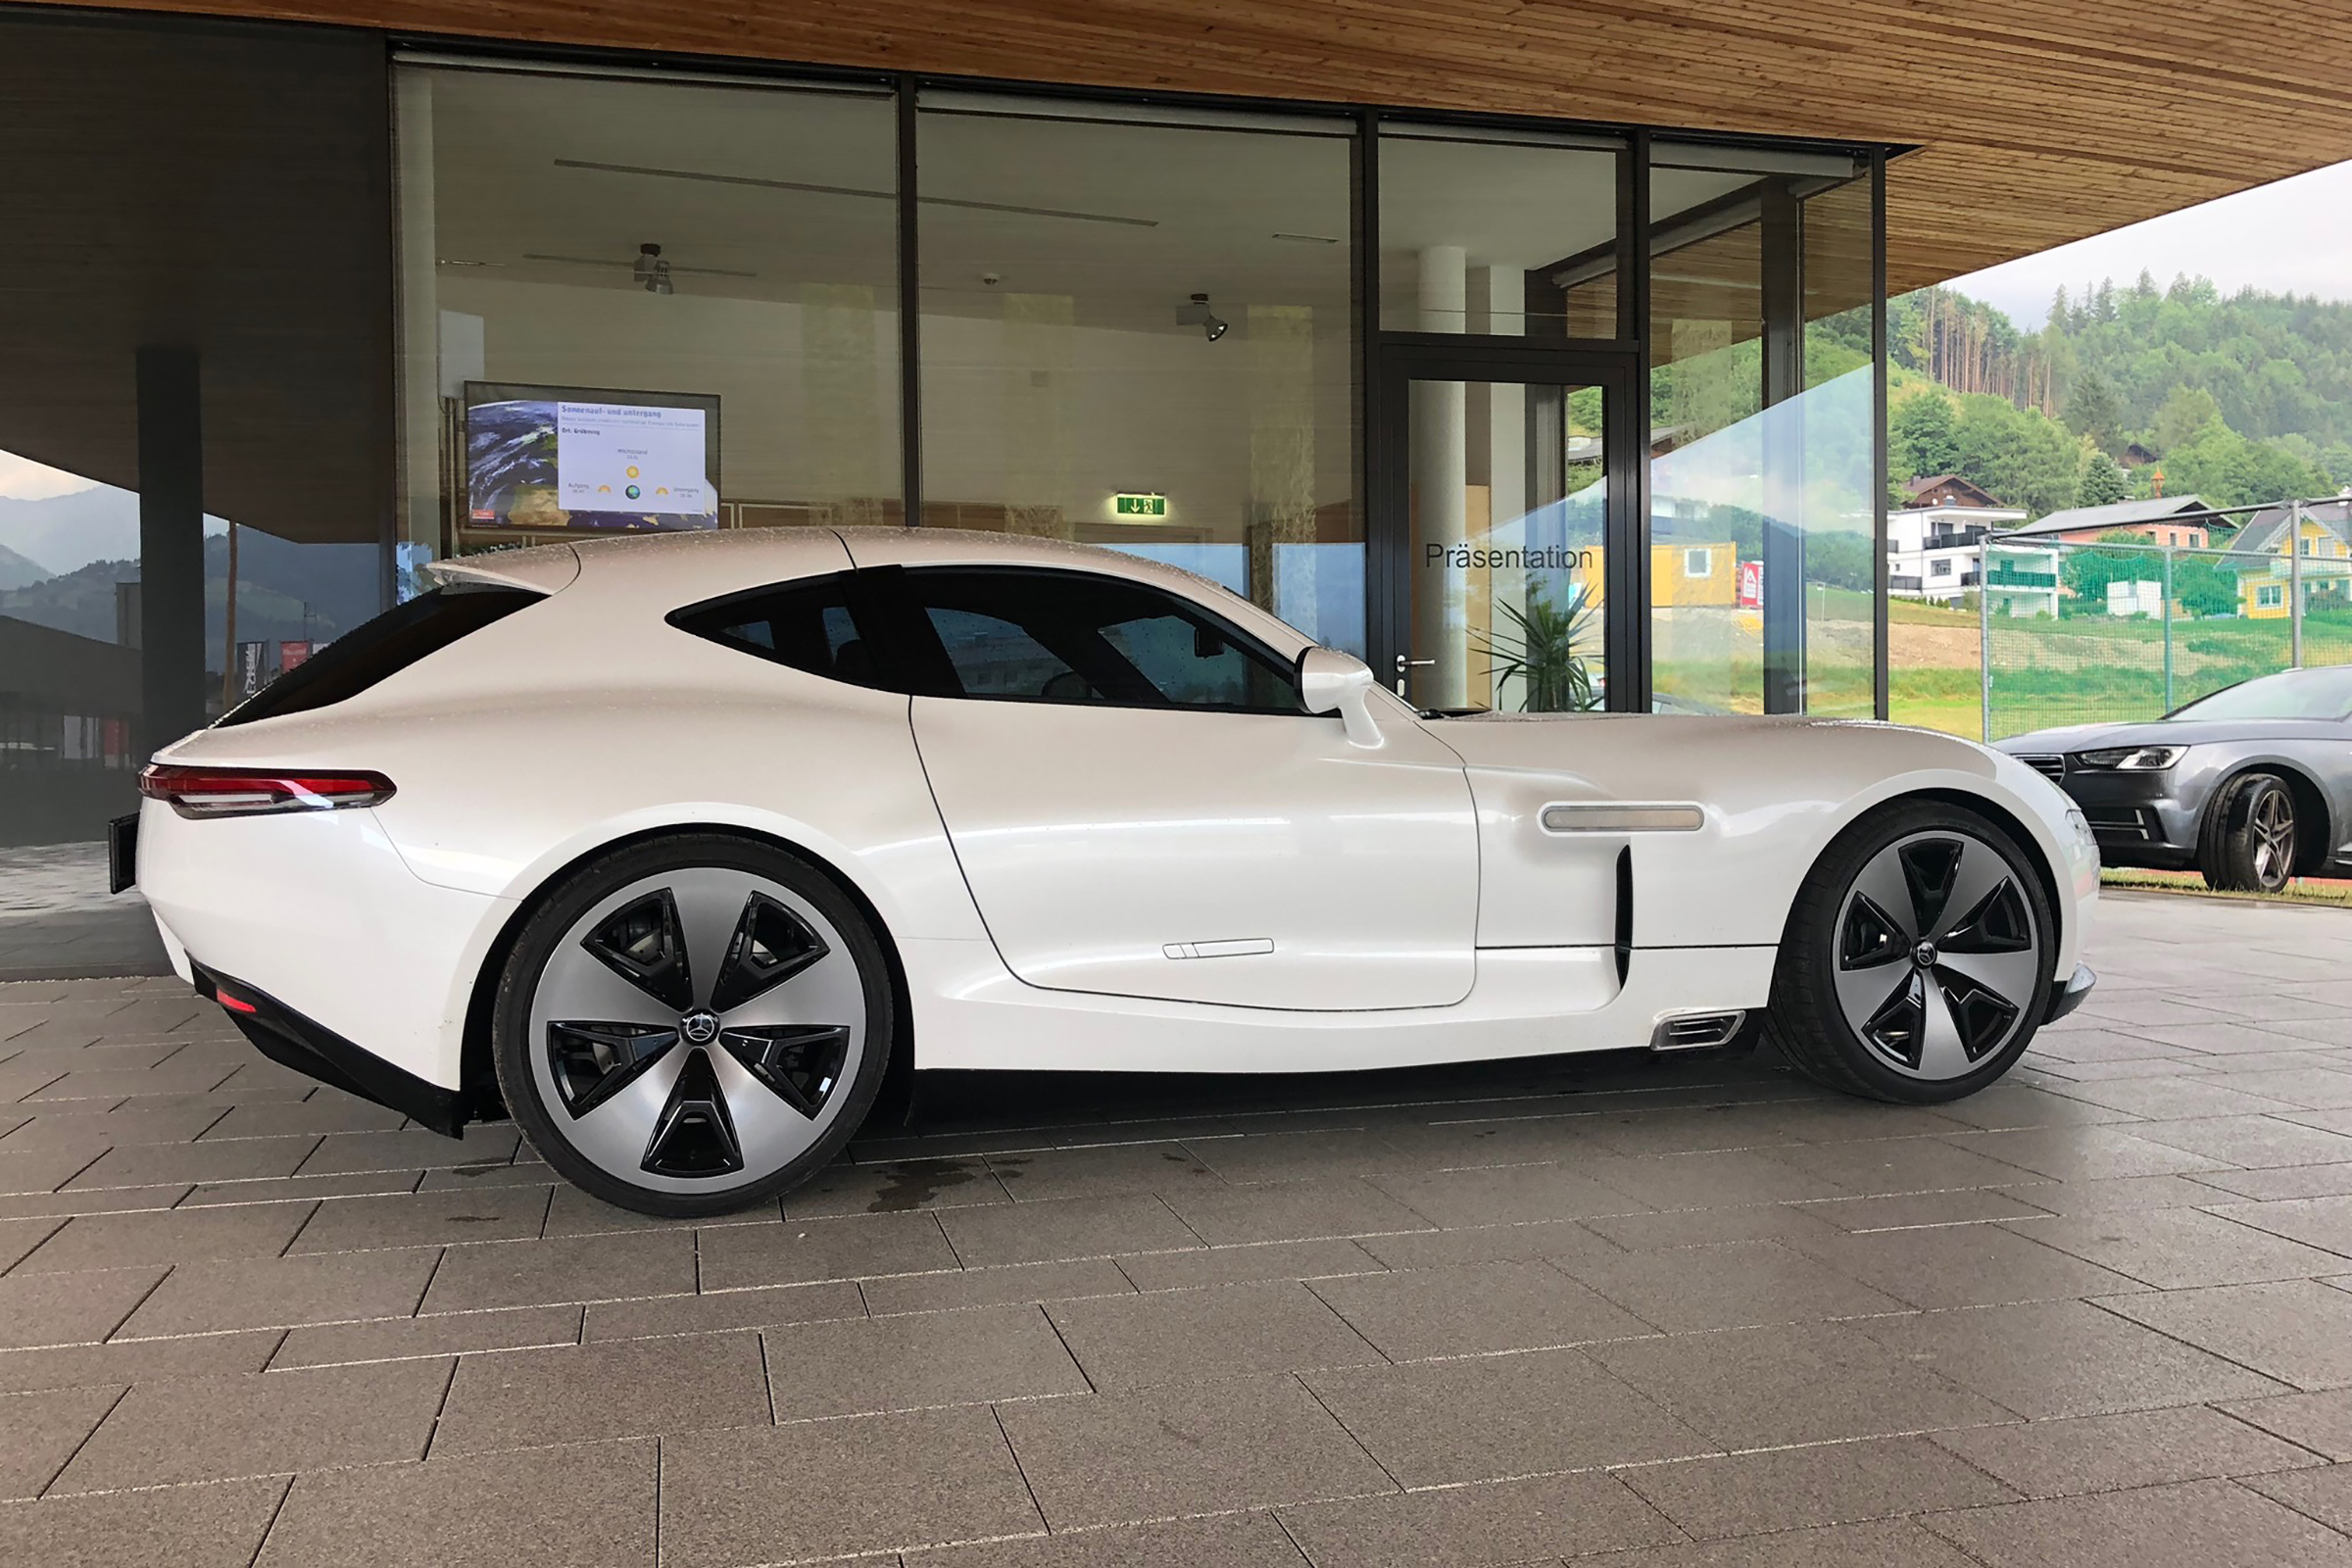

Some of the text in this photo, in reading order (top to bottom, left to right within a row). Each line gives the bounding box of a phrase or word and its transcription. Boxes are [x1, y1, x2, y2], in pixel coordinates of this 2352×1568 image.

[562, 406, 605, 415] Sonnenauf-
[623, 410, 662, 418] untergang
[1426, 543, 1593, 569] Präsentation
